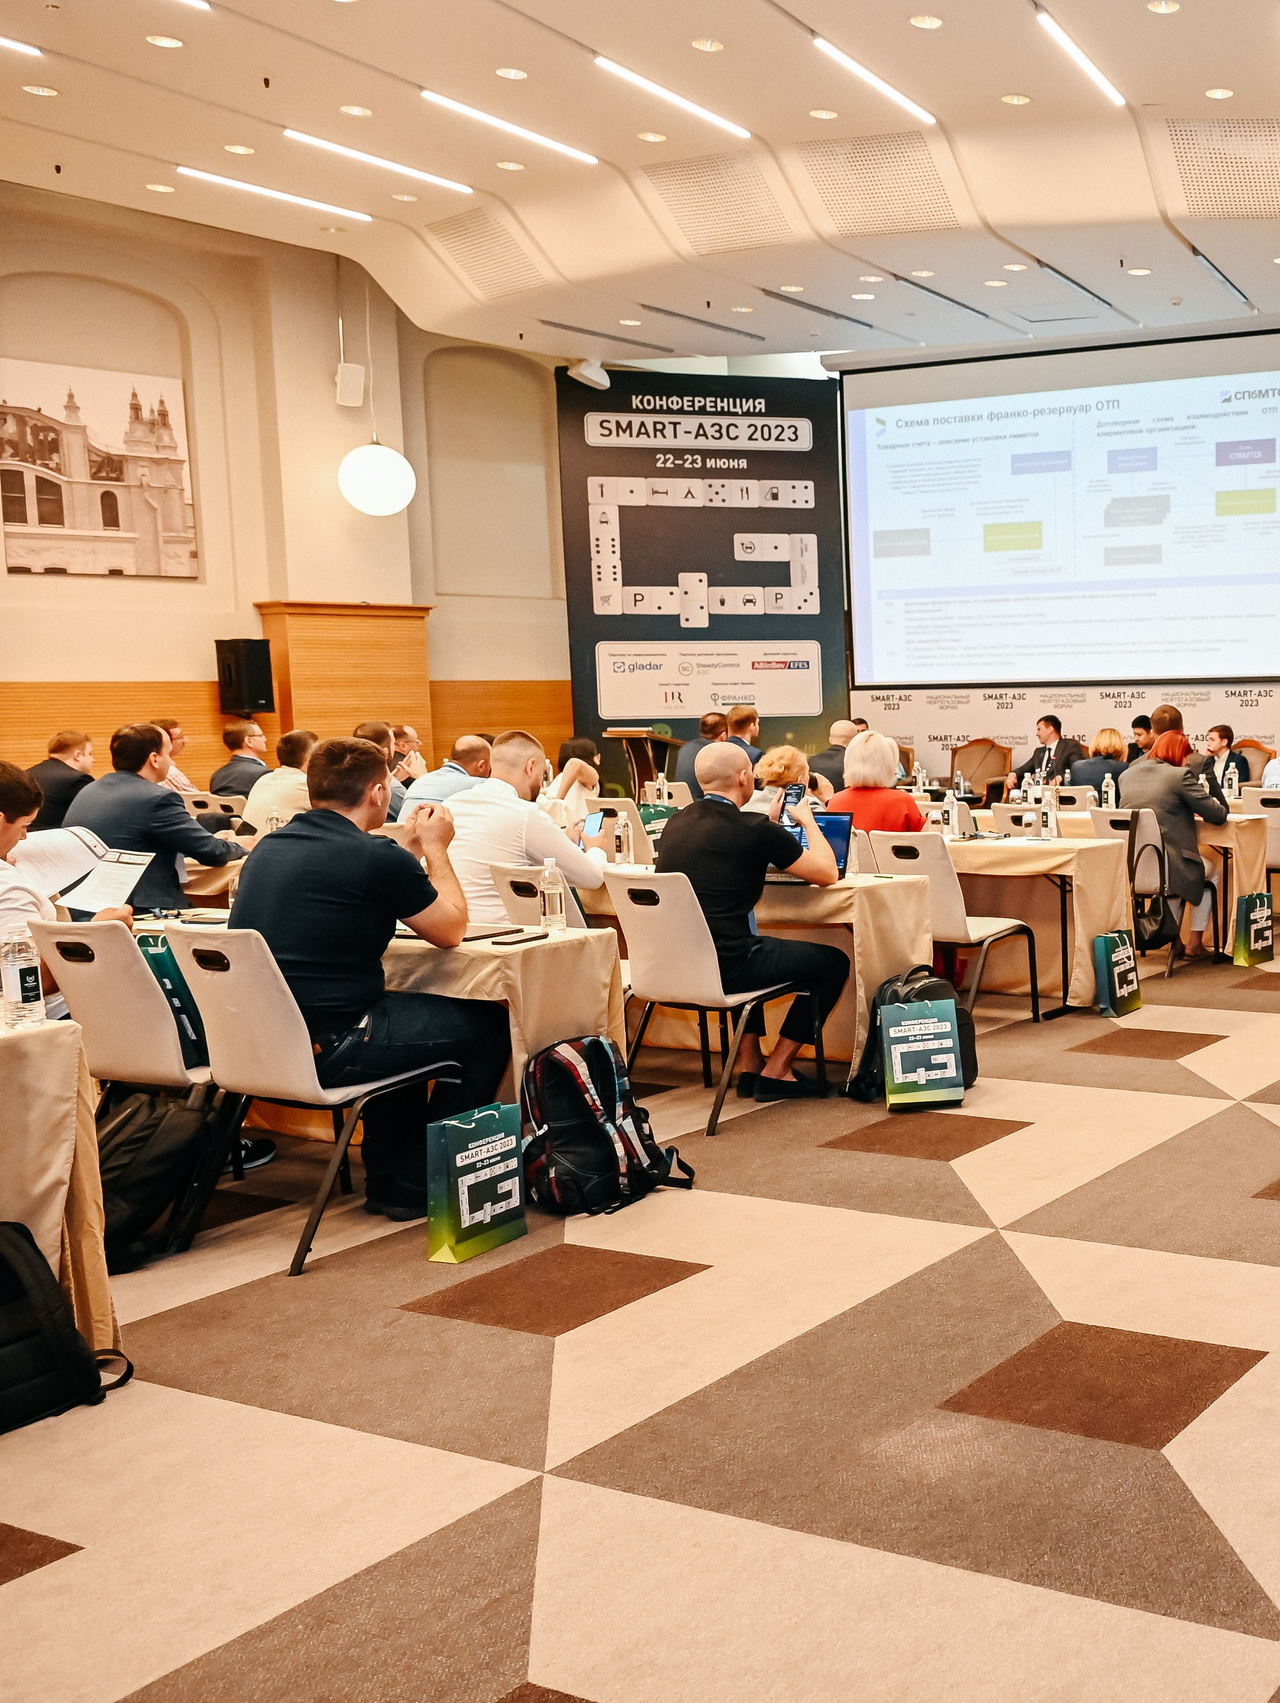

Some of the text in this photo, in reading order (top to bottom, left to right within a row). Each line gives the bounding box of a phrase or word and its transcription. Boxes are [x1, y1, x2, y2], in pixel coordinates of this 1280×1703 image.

[632, 395, 766, 414] КОНФЕРЕНЦИЯ
[895, 399, 1120, 430] Схема поставки франко-резервуар ОТП
[1096, 417, 1141, 429] Договорная
[1152, 415, 1175, 424] схема
[1187, 409, 1249, 421] взаимодействия
[1261, 406, 1279, 415] ОТП
[599, 419, 800, 442] SMART-АЗС 2023
[706, 457, 747, 470] июня
[628, 662, 663, 673] gladar
[696, 662, 740, 670] SteadyControl
[790, 661, 808, 669] EFES
[871, 694, 912, 702] SMART-АЗС
[982, 693, 1027, 701] SMART-АЗС
[1099, 691, 1146, 700] SMART-АЗС
[1224, 689, 1274, 698] SMART-АЗС
[883, 703, 900, 711] 2023
[1114, 700, 1132, 708] 2023
[1239, 699, 1259, 707] 2023
[460, 1138, 513, 1163] SMART-АЗС 2023
